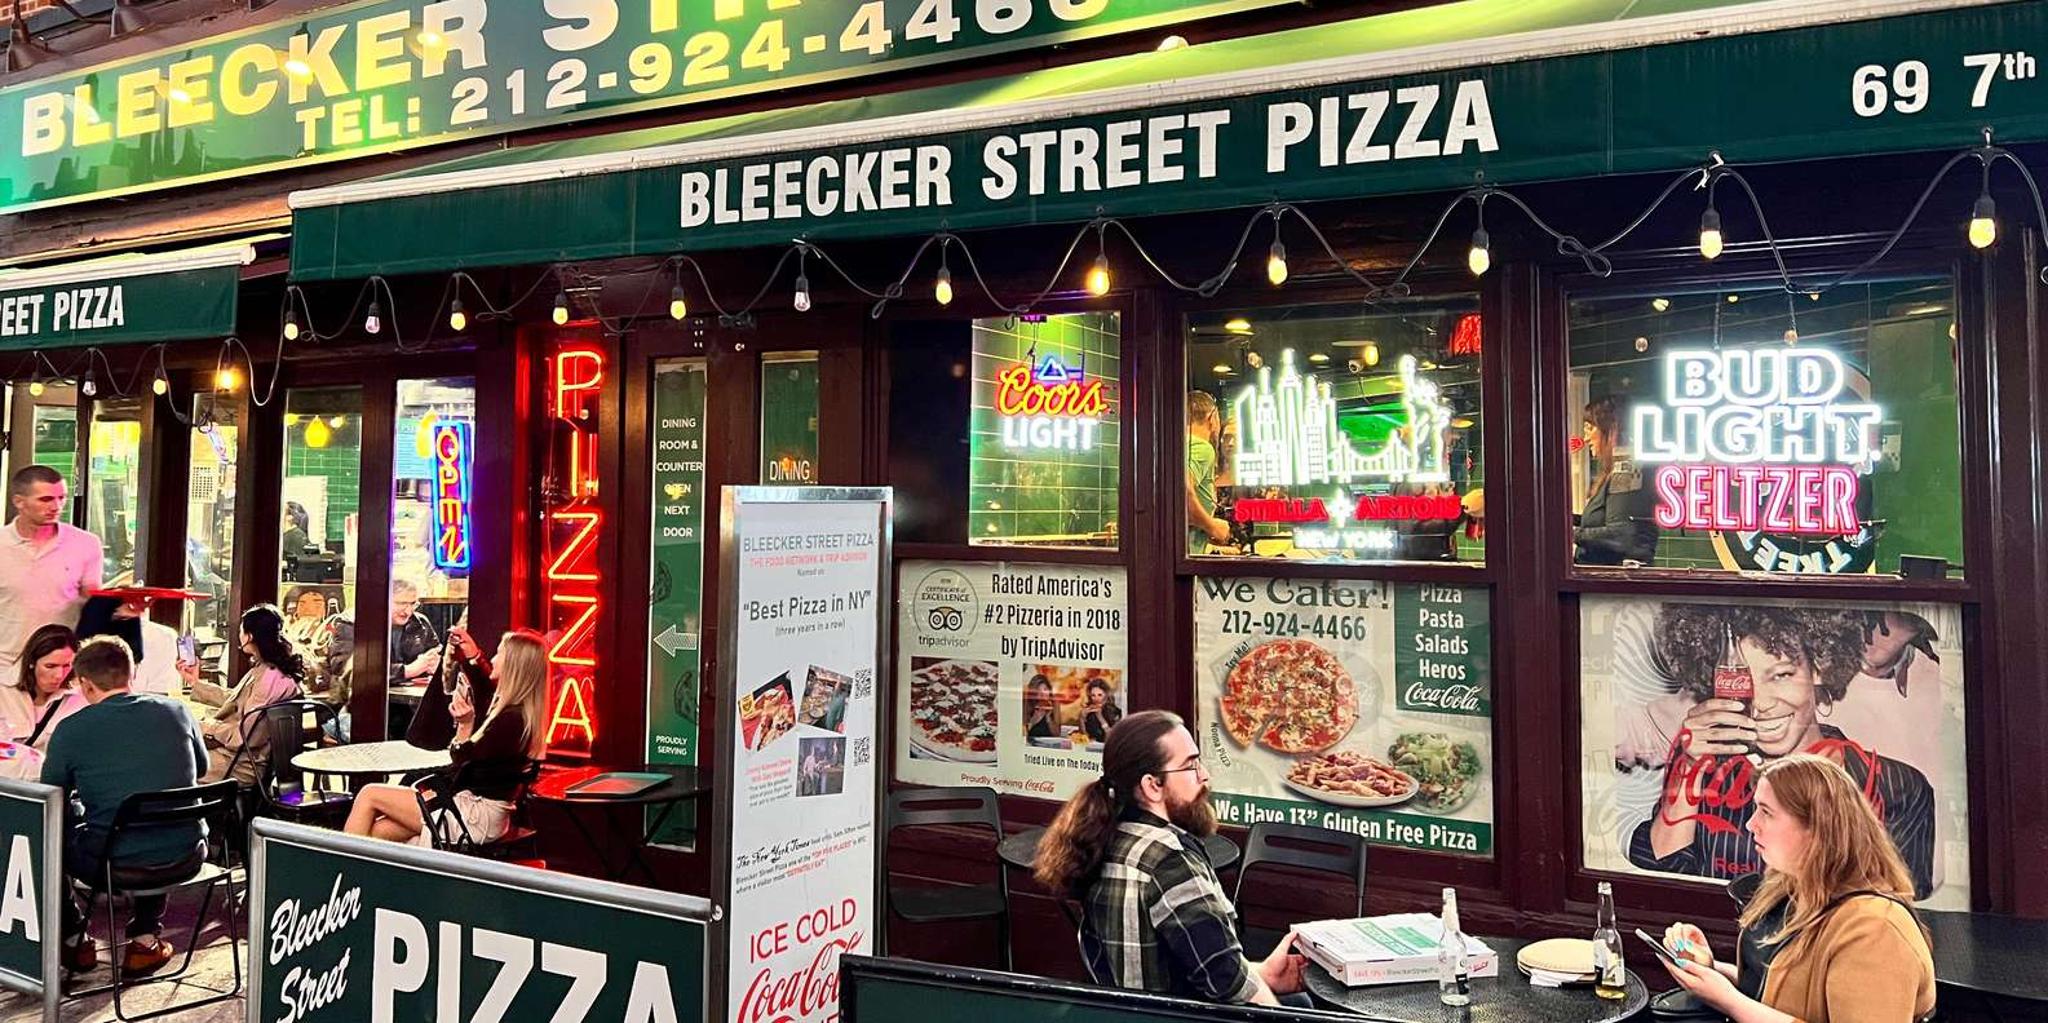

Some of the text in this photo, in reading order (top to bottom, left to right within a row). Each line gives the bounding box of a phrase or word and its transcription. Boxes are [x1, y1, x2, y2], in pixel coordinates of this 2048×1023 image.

[21, 0, 487, 156] BLEECKER
[1852, 51, 2037, 117] 69 7th
[295, 93, 421, 151] TEL:
[680, 78, 1500, 228] BLEECKER STREET PIZZA
[0, 285, 124, 336] EET PIZZA
[1667, 348, 1844, 405] BUD
[1000, 367, 1106, 416] Coors
[662, 418, 696, 428] DINING
[1003, 416, 1097, 450] LIGHT
[1634, 404, 1881, 463] LIGHT
[659, 440, 698, 450] ROOM &
[656, 461, 703, 472] COUNTER
[769, 460, 811, 481] DINING
[436, 427, 465, 563] OPEN
[1656, 466, 1860, 535] SELTZER
[664, 506, 690, 515] NEXT
[1234, 495, 1462, 522] STELLA ARTOIS
[663, 527, 693, 537] DOOR
[744, 532, 873, 552] BLEECKER STREET PIZZA
[1295, 530, 1394, 548] NEW YORK
[545, 350, 602, 744] PIZZA
[921, 593, 970, 602] EXCELLENCE
[992, 574, 1112, 598] Rated America's
[1202, 577, 1389, 610] We Cater!
[1420, 584, 1462, 604] Pizza
[789, 596, 826, 617] Pizza
[831, 594, 843, 612] in
[984, 604, 1120, 630] #2 Pizzeria in 2018
[797, 623, 816, 634] years
[1222, 610, 1366, 641] 212-924-4466
[1419, 609, 1464, 630] Pasta
[919, 635, 969, 648] tripadvisor
[1001, 634, 1105, 661] by TripAdvisor
[1415, 634, 1469, 655] Salads
[1419, 659, 1466, 680] Heros
[1405, 681, 1484, 712] Coca-Cola
[656, 735, 688, 745] PROUDLY
[657, 746, 687, 756] SERVING
[1024, 754, 1041, 765] Tried
[1042, 755, 1055, 766] Live
[1056, 758, 1065, 767] on
[961, 773, 990, 785] Proudly
[993, 777, 1023, 788] Serving
[1216, 799, 1239, 822] We
[1244, 804, 1284, 824] Have
[1323, 812, 1380, 838] Gluten
[1386, 819, 1424, 844] Free
[1430, 825, 1478, 850] Pizza
[1715, 857, 1756, 874] Real
[270, 872, 361, 966] Bleecker
[750, 898, 856, 964] ICE COLD
[276, 947, 351, 1023] Street
[738, 930, 865, 1023] Coca-Co
